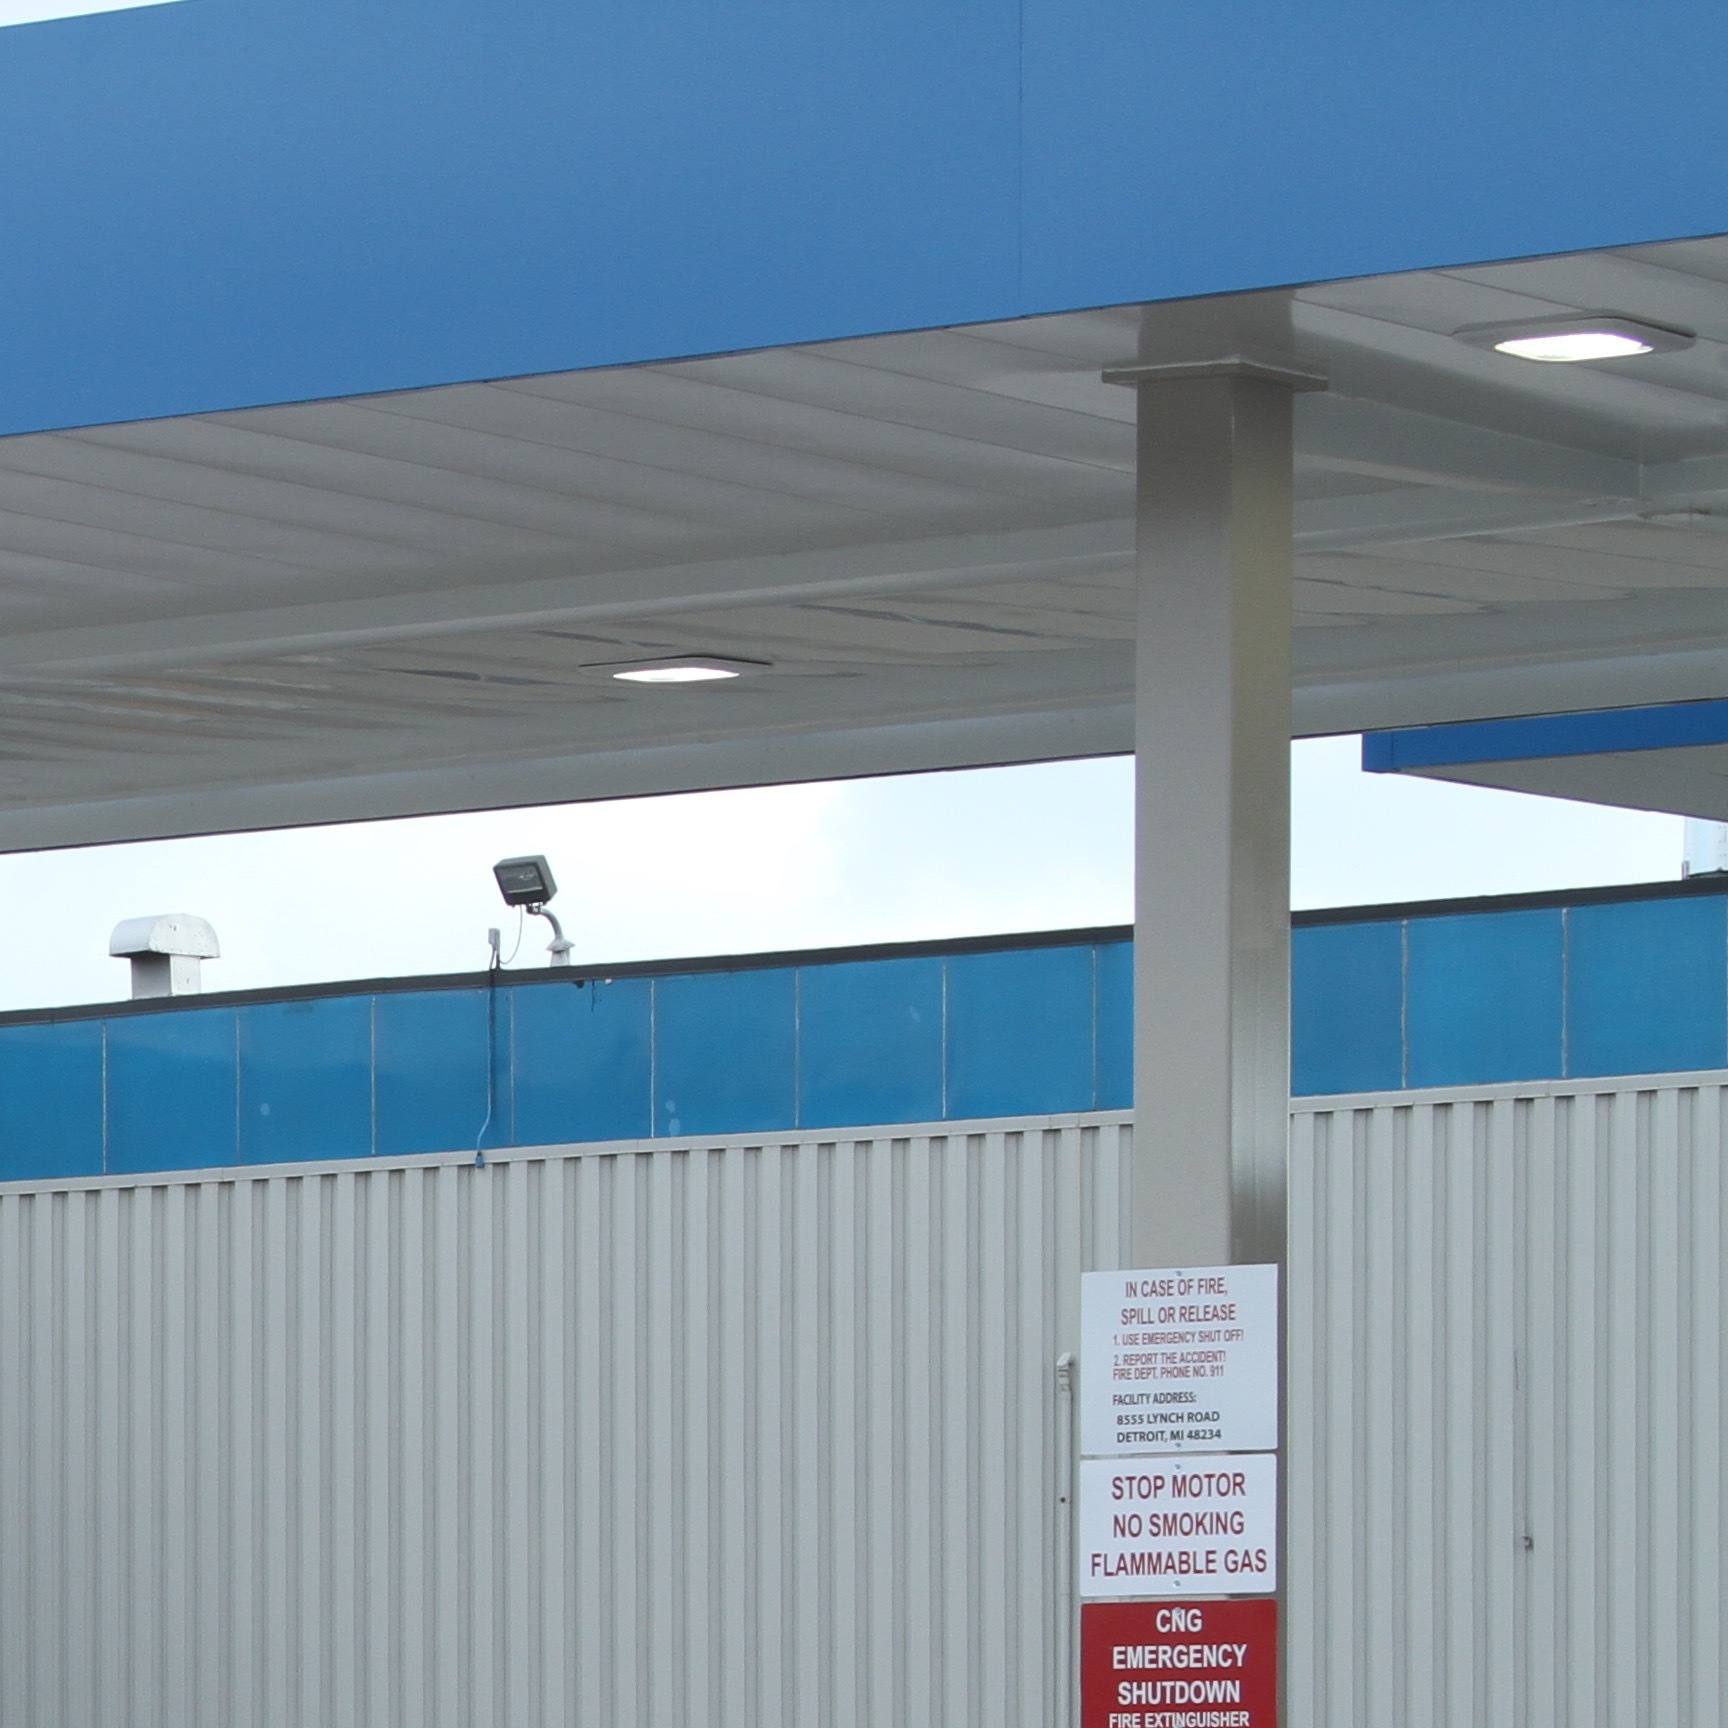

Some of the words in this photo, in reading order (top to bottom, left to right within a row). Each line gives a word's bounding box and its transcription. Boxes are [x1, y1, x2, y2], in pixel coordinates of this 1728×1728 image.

[1125, 1281, 1137, 1298] IN
[1141, 1279, 1174, 1297] CASE
[1178, 1279, 1194, 1296] OF
[1197, 1277, 1228, 1296] FIRE,
[1121, 1308, 1154, 1326] SPILL
[1158, 1306, 1177, 1324] OR
[1179, 1303, 1236, 1323] RELEASE
[1122, 1333, 1140, 1346] USE
[1141, 1330, 1196, 1345] EMERGENCY
[1198, 1330, 1222, 1343] SHUT
[1114, 1354, 1121, 1367] 2.
[1123, 1352, 1159, 1366] REPORT
[1161, 1352, 1177, 1365] THE
[1113, 1368, 1133, 1381] FIRE
[1134, 1367, 1159, 1380] DEPT.
[1161, 1366, 1190, 1379] PHONE
[1193, 1365, 1208, 1378] NO.
[1210, 1364, 1224, 1377] 911
[1113, 1393, 1151, 1406] FACILITY
[1153, 1391, 1197, 1404] ADDRESS:
[1116, 1413, 1144, 1425] 8555
[1147, 1412, 1184, 1424] LYNCH
[1187, 1411, 1220, 1423] ROAD
[1117, 1430, 1168, 1443] DETROIT,
[1170, 1430, 1184, 1441] MI
[1187, 1429, 1222, 1441] 48234
[1112, 1475, 1165, 1500] STOP
[1172, 1473, 1246, 1498] MOTOR
[1113, 1513, 1142, 1538] NO
[1149, 1511, 1244, 1537] SMOKING
[1091, 1550, 1217, 1577] FLAMMABLE
[1224, 1548, 1267, 1573] GAS
[1156, 1608, 1202, 1633] CNG
[1112, 1644, 1247, 1670] EMERGENCY
[1117, 1680, 1240, 1705] SHUTDOWN
[1109, 1713, 1141, 1728] FIRE
